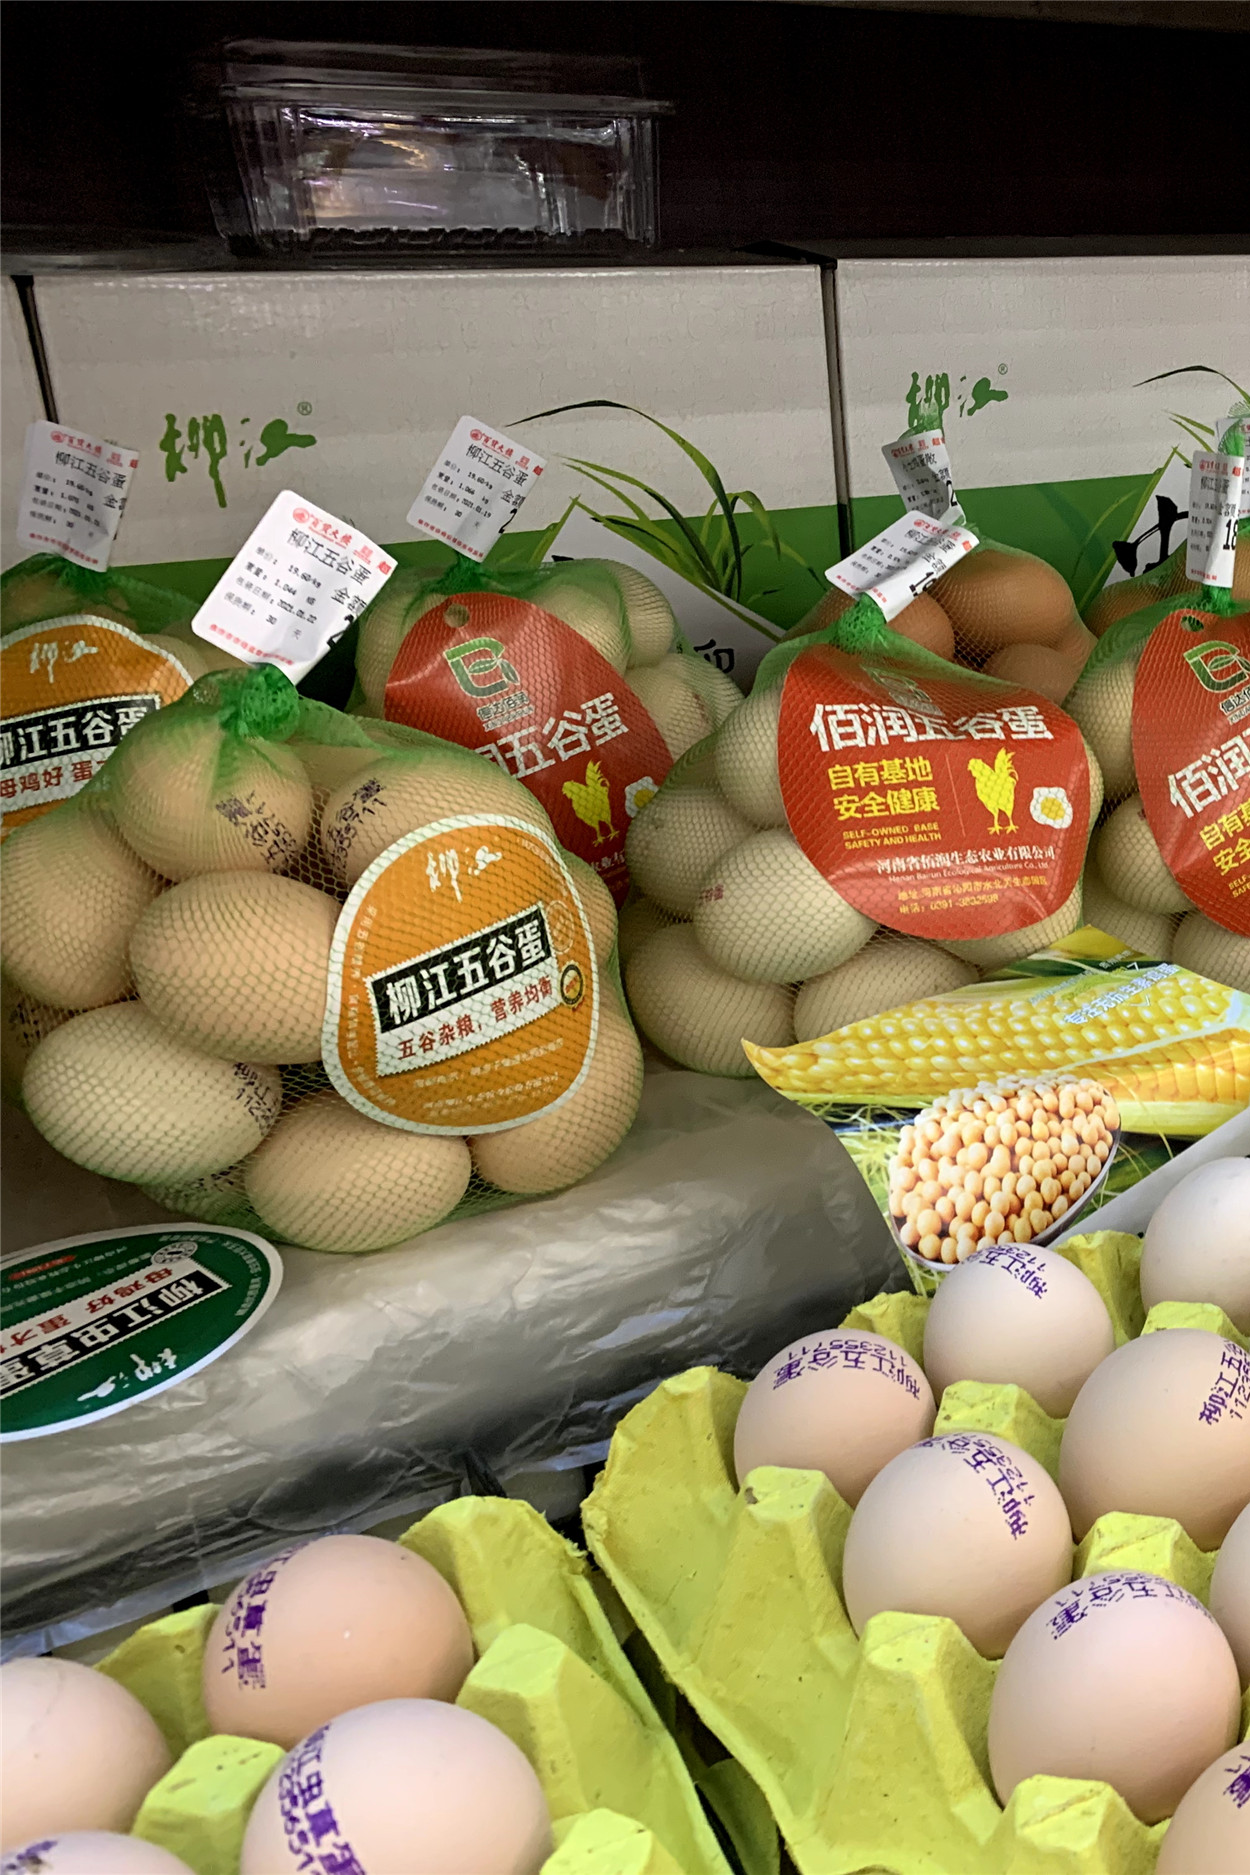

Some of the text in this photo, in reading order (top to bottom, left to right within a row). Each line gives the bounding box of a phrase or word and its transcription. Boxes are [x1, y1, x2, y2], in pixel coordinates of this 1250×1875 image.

[55, 450, 126, 489] 柳江五谷蛋
[466, 443, 529, 488] 柳江五谷蛋
[287, 528, 372, 585] 柳江五谷蛋
[809, 702, 1055, 752] 佰润五谷蛋
[0, 759, 106, 799] 母鸡好 蛋
[828, 755, 934, 791] 自有基地
[833, 786, 941, 821] 安全健康
[845, 832, 942, 850] SAFETY AND HEALTH
[914, 821, 940, 833] BASE
[386, 918, 546, 1025] 柳江五谷蛋
[490, 974, 554, 1023] 营养均衡
[85, 1266, 173, 1314] 母鸡好
[0, 1313, 72, 1355] 蛋才
[773, 1350, 921, 1401] 柳江五谷蛋
